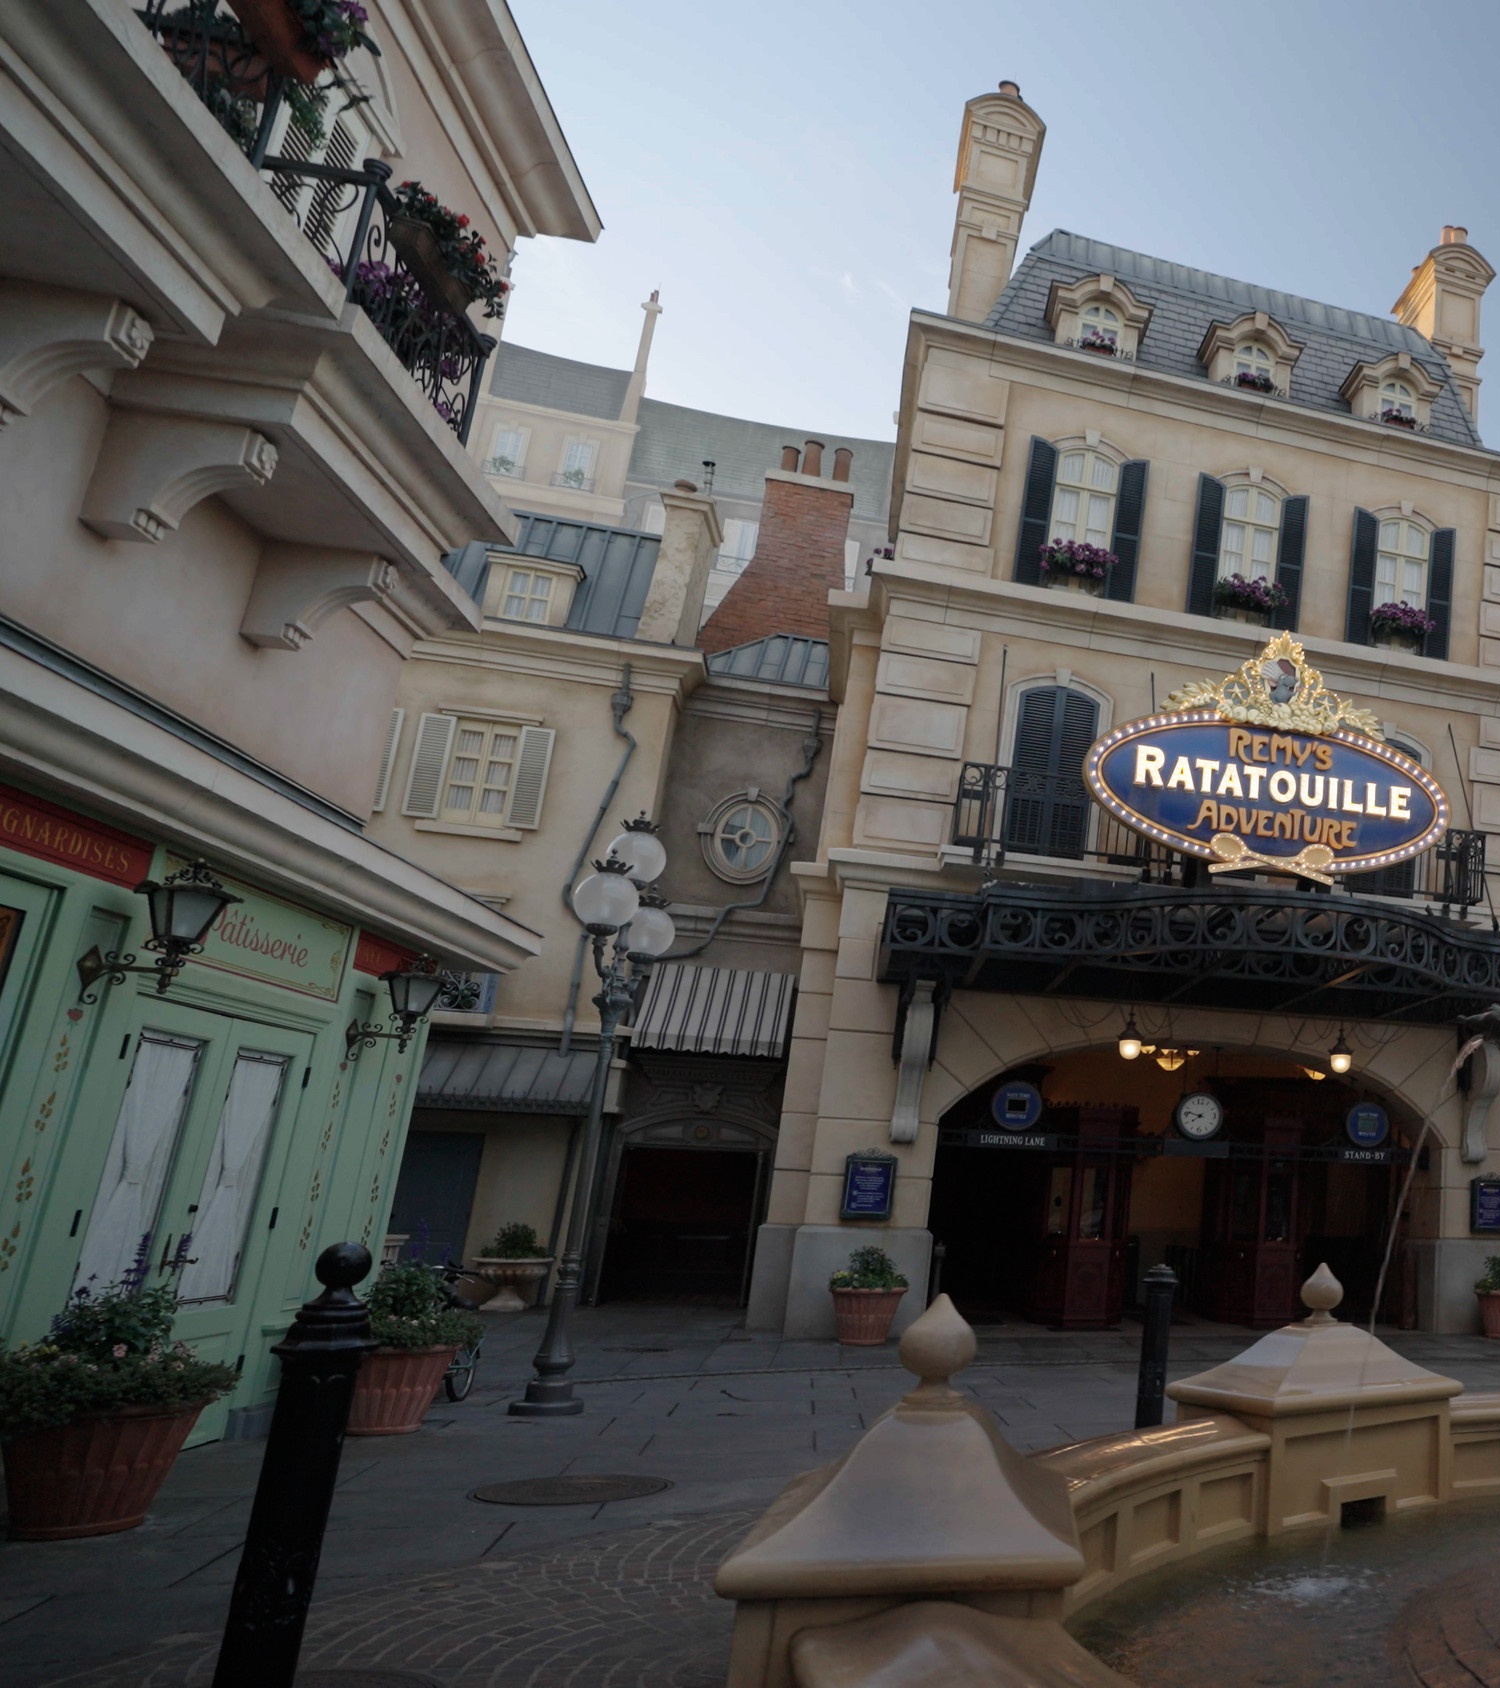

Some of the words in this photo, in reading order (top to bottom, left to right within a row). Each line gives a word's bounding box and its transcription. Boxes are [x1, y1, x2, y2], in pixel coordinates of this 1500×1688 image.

[1228, 727, 1333, 771] REMY'S
[1133, 744, 1412, 821] RATATOUILLE
[0, 806, 132, 873] GNARDISES
[1186, 799, 1358, 850] ADVENTURE
[980, 1134, 1023, 1146] LIGHTNING
[1024, 1136, 1046, 1147] LANE
[1344, 1150, 1386, 1160] STAND-BY
